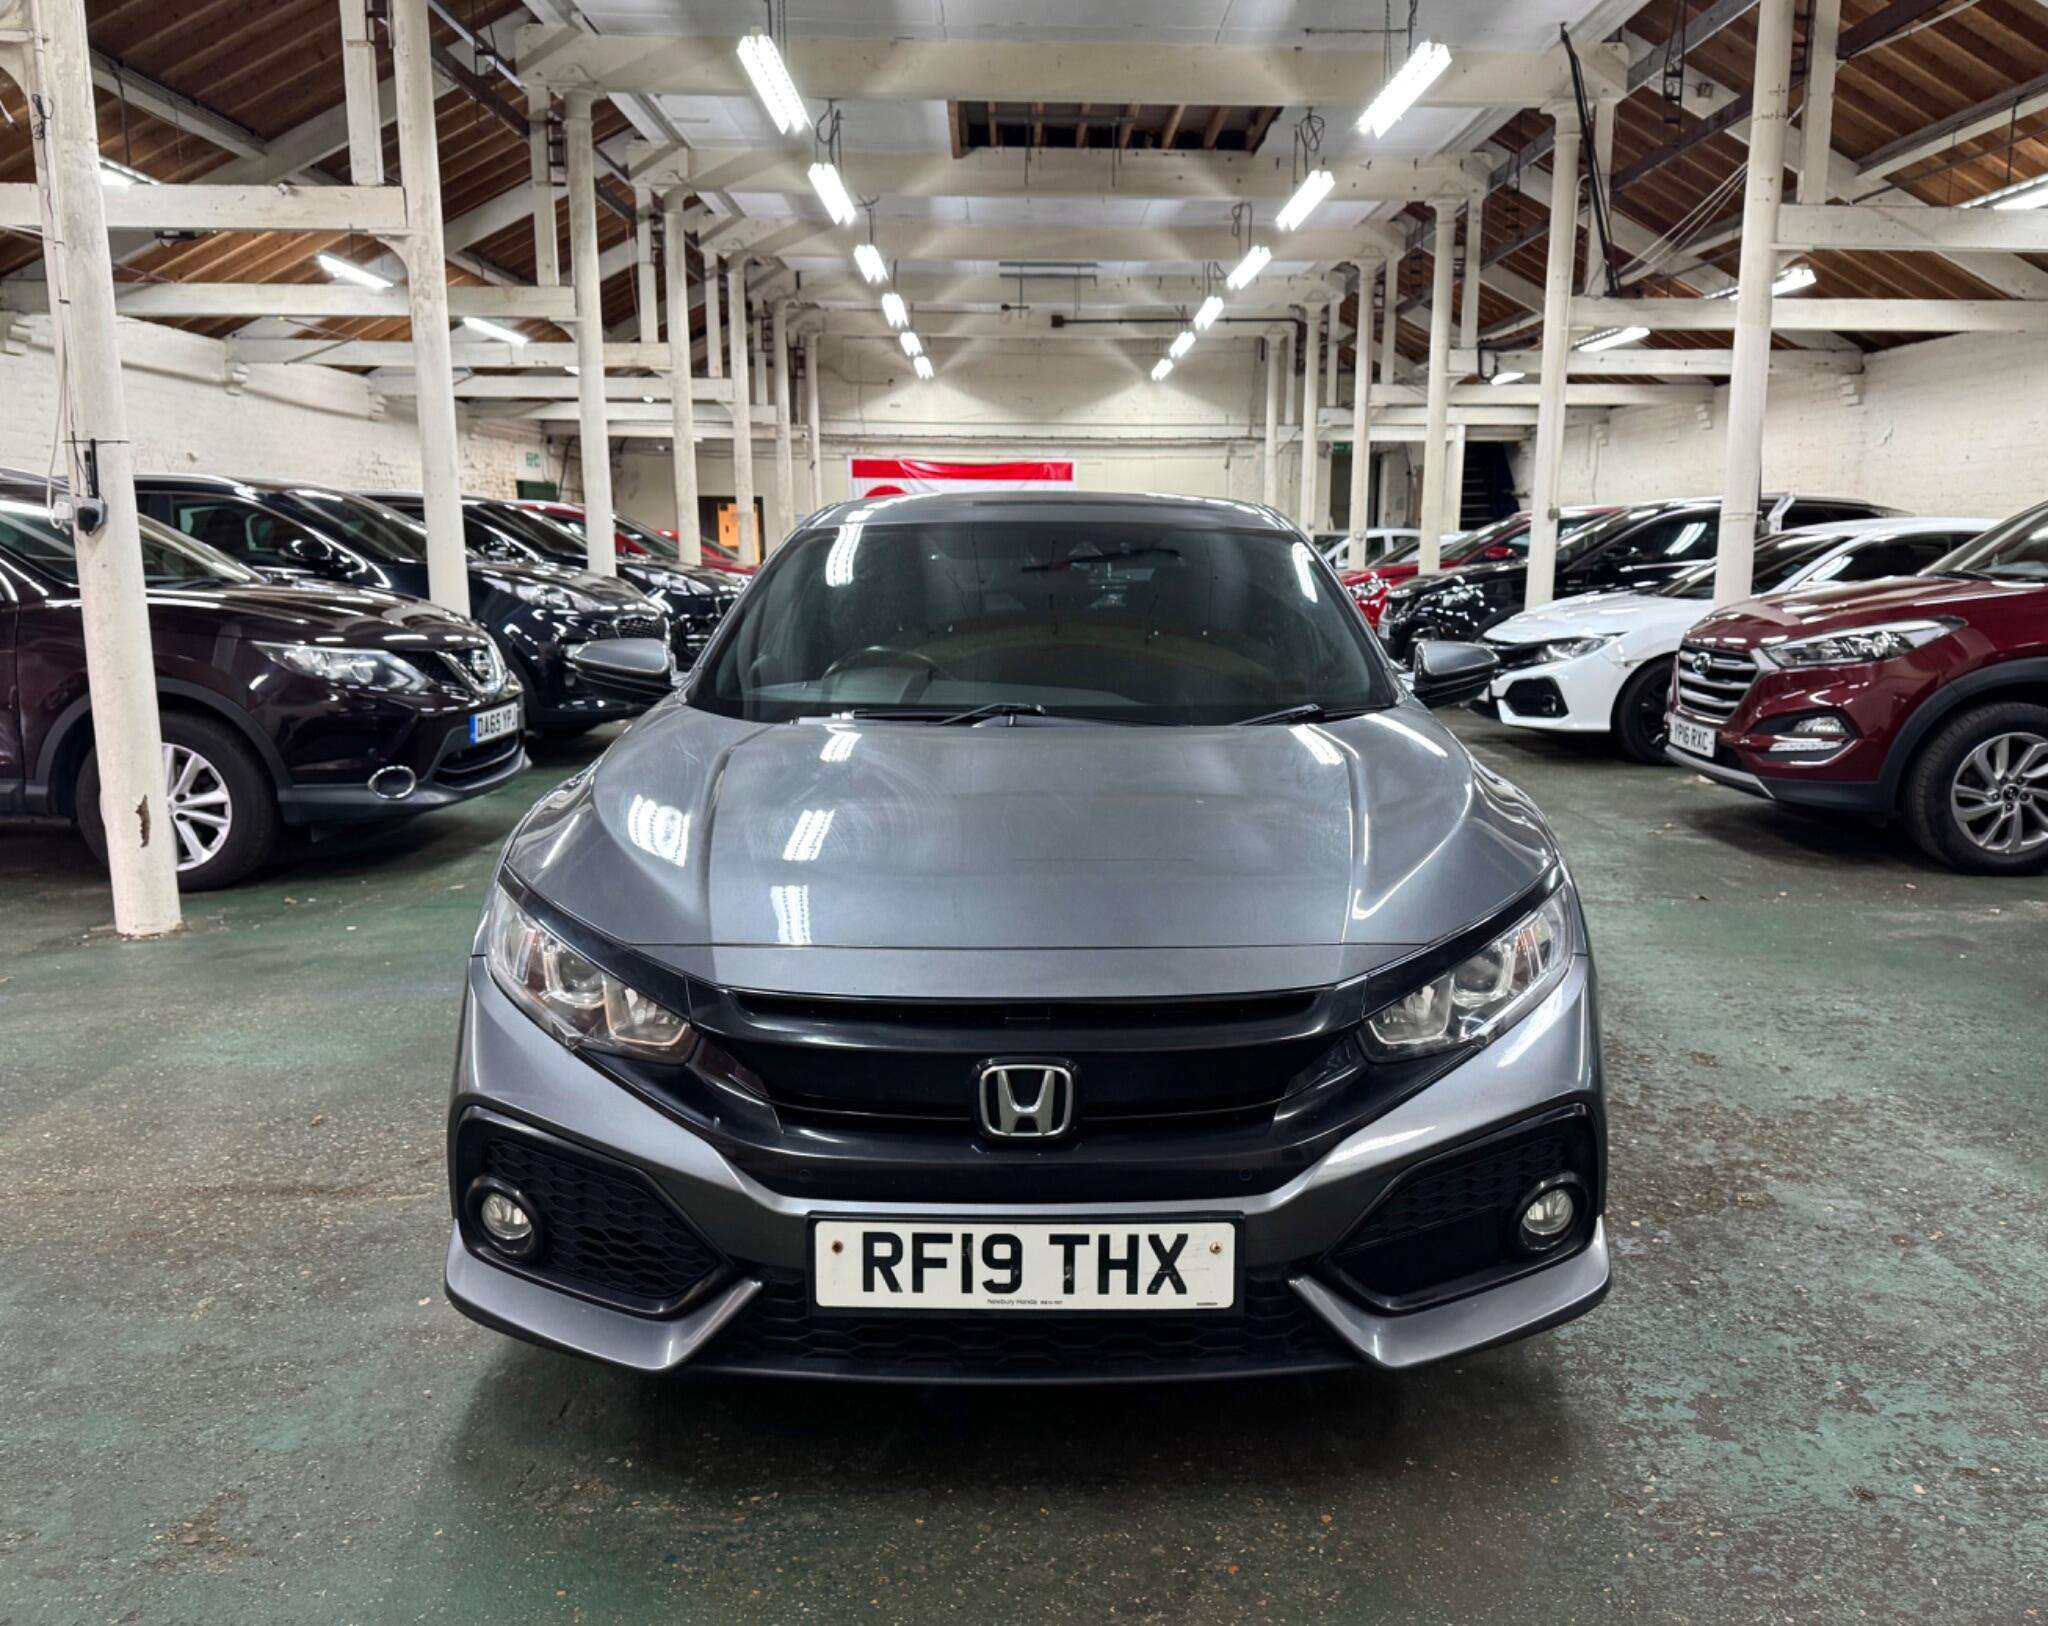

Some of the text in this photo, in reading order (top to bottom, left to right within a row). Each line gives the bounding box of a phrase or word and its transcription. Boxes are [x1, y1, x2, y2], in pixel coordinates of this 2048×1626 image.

[477, 712, 501, 737] DA65
[1674, 723, 1708, 750] YP16 RXC
[862, 1231, 1189, 1296] RF19 THX
